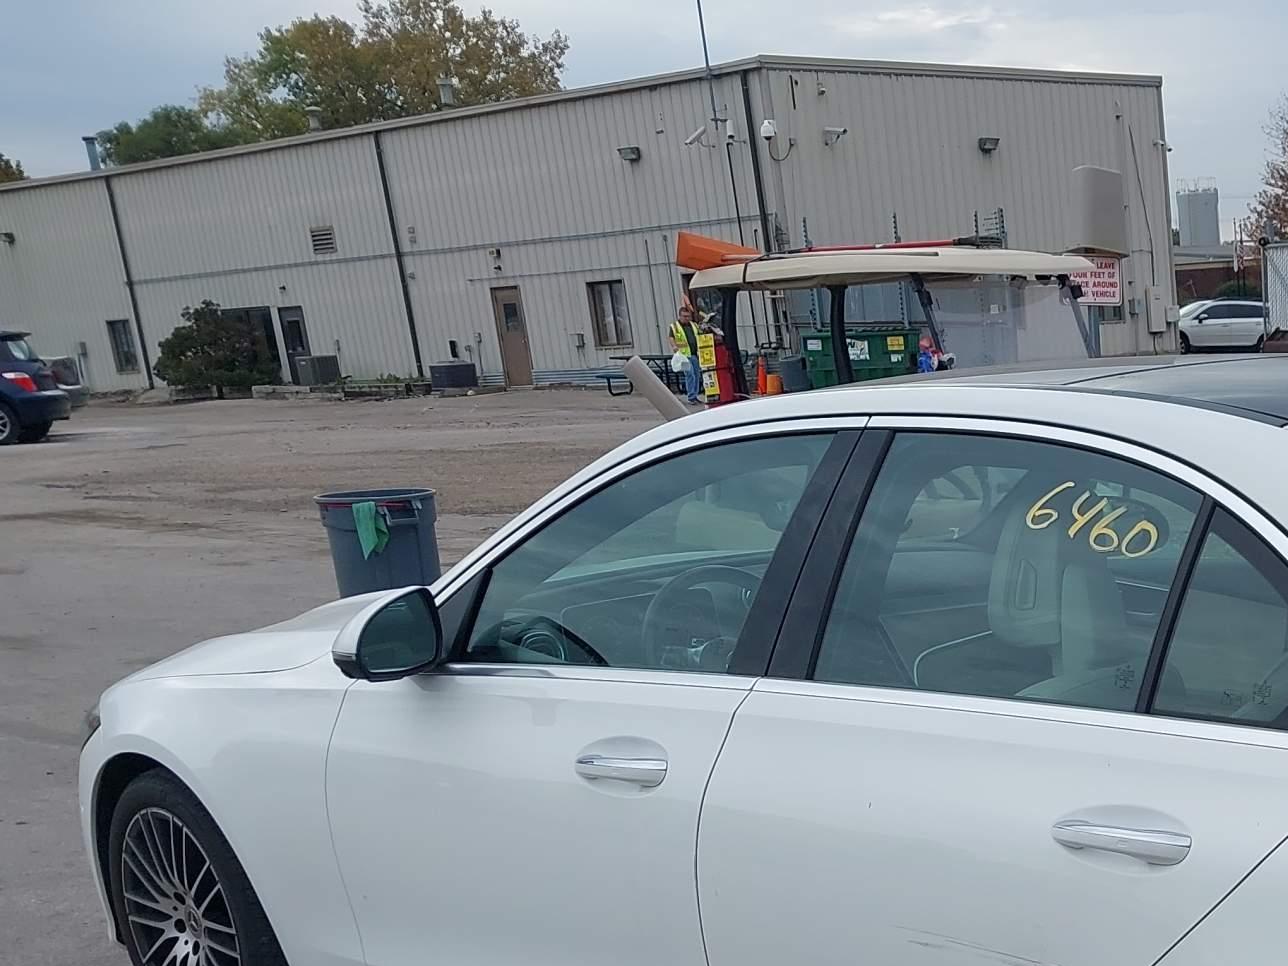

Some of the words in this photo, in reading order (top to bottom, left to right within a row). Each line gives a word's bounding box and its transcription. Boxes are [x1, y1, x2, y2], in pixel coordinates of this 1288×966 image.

[1096, 262, 1115, 270] LEAVE
[1090, 271, 1106, 279] FEET
[1107, 271, 1116, 279] OF
[1092, 281, 1119, 289] AROUND
[1091, 290, 1117, 298] VEHICLE
[1025, 480, 1159, 558] 6460
